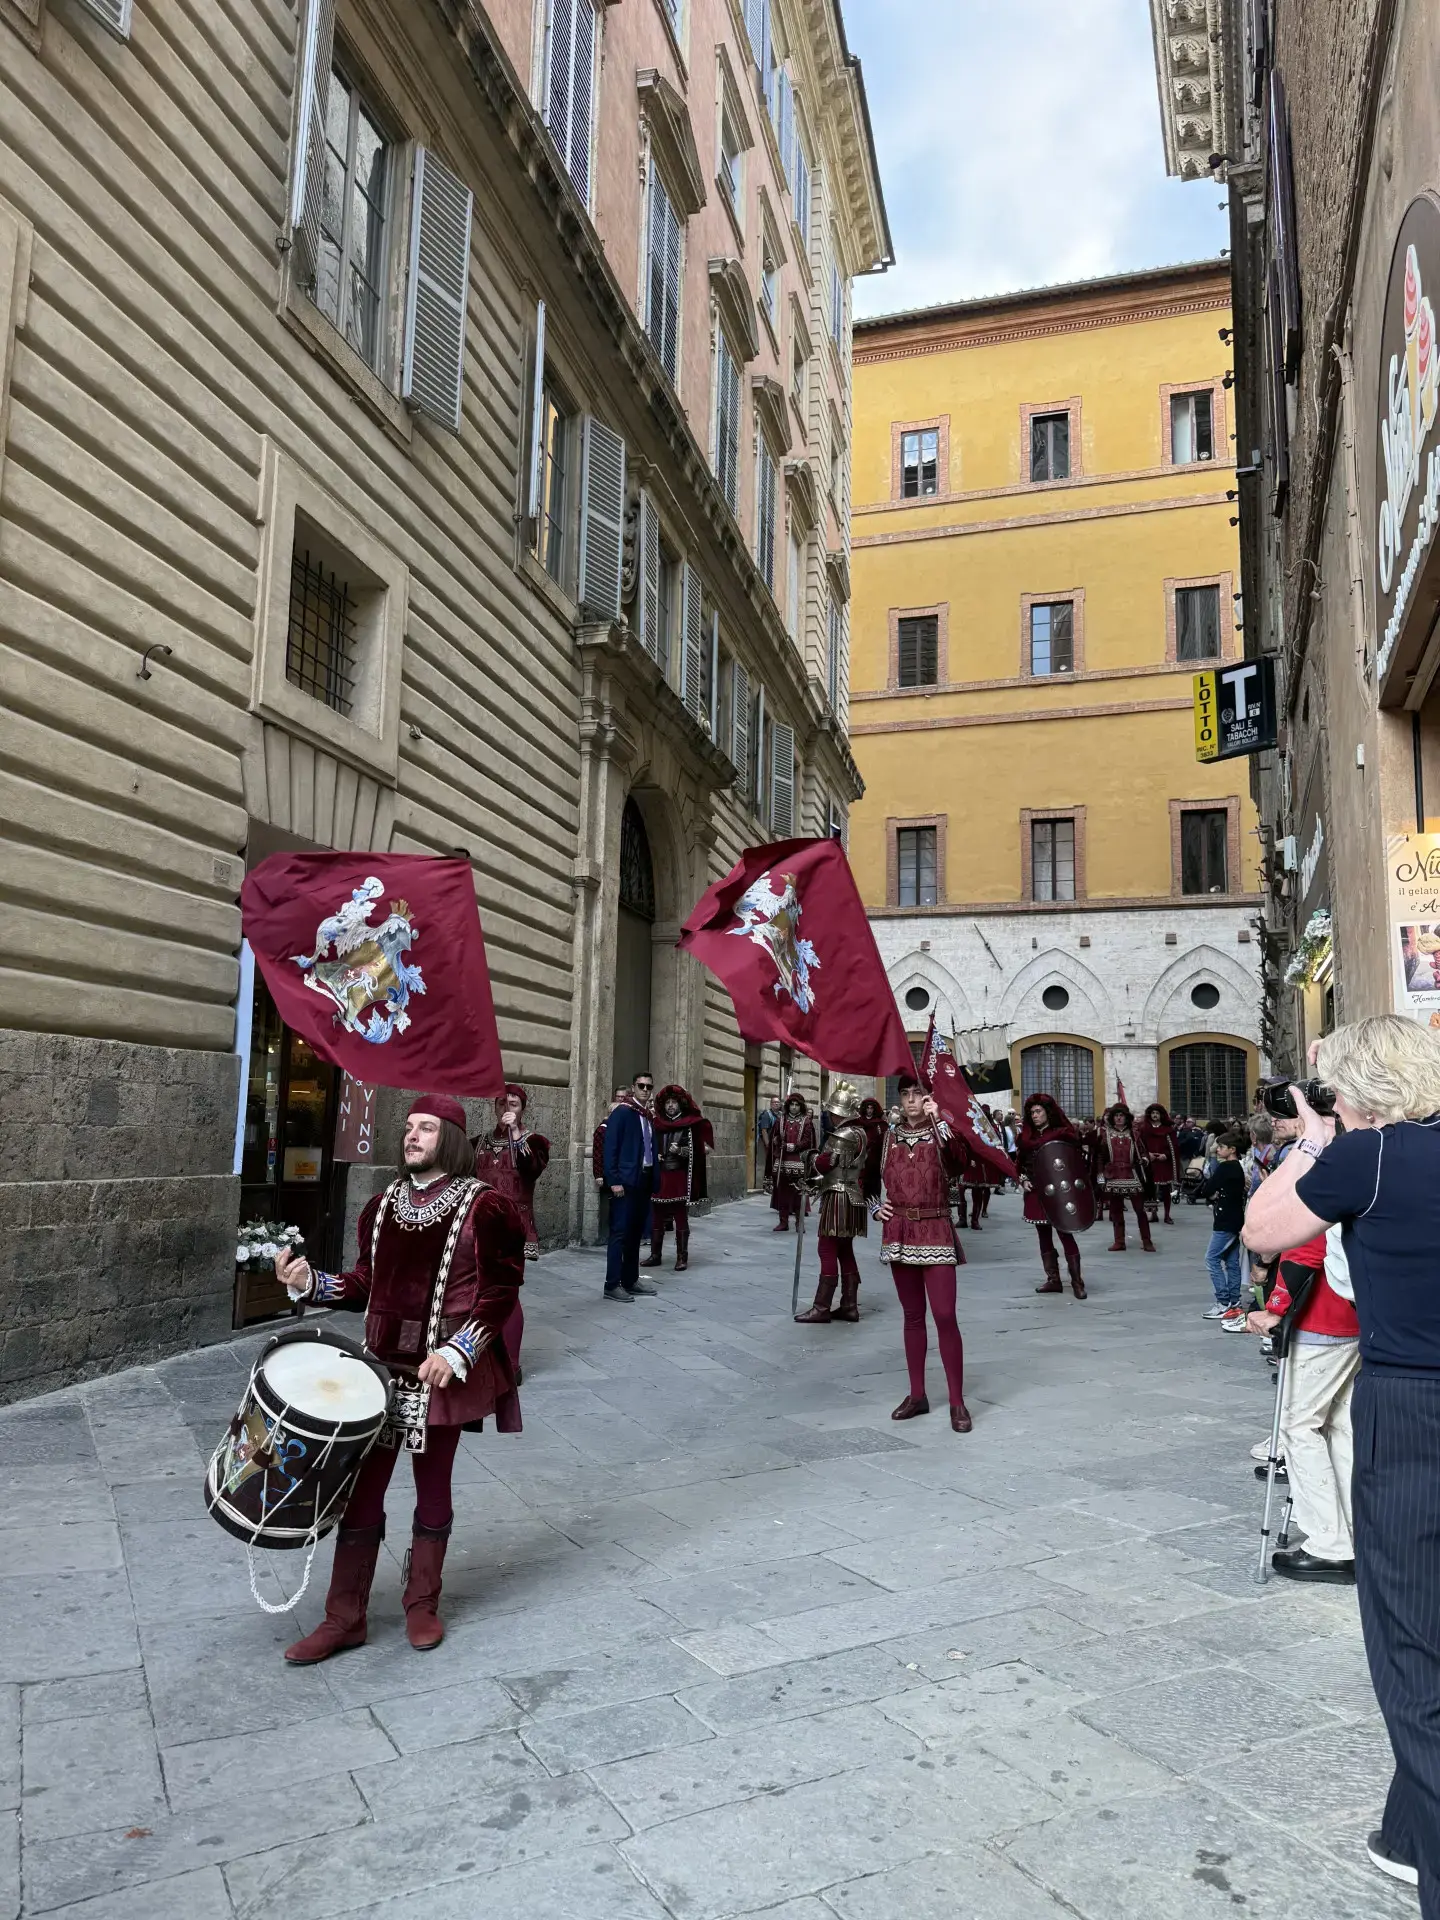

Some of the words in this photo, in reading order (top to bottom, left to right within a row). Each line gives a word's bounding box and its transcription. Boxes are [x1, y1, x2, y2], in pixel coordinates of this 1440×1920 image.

[1199, 676, 1212, 741] LOTTO
[1222, 665, 1257, 720] T
[1227, 727, 1258, 741] TABACCHI
[1231, 721, 1245, 732] SALI
[1248, 719, 1252, 728] E
[1398, 887, 1404, 895] il
[1408, 887, 1438, 896] gelato
[357, 1089, 374, 1154] VINO
